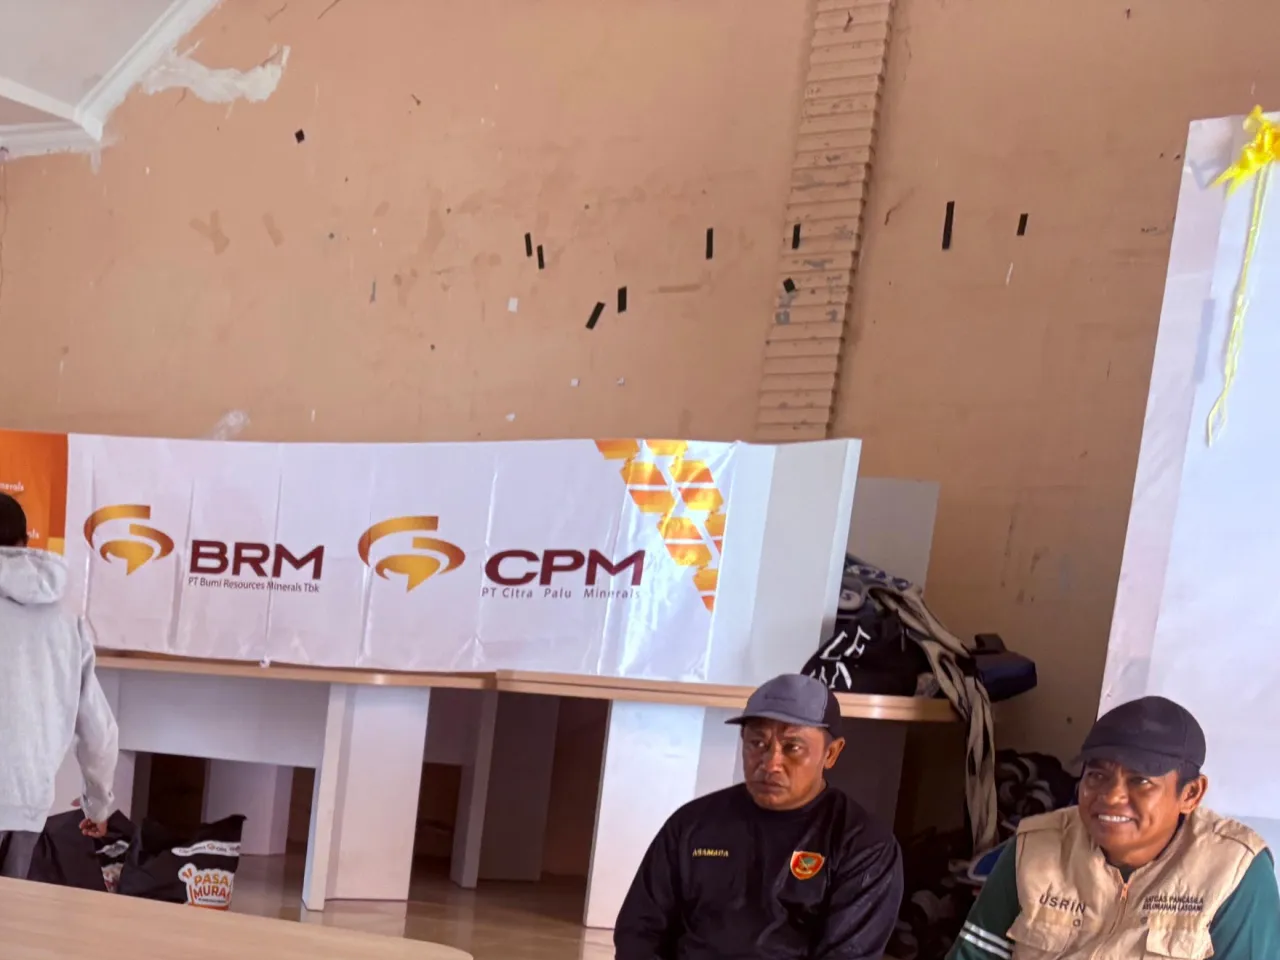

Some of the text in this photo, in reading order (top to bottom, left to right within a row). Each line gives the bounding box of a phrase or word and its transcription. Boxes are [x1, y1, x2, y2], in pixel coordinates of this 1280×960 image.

[190, 540, 324, 580] BRM
[485, 549, 646, 586] CPM
[188, 577, 319, 592] PT Bumi Resources Minerals Tbk
[482, 588, 640, 598] PT Citra Palu Minerals
[194, 873, 229, 886] PASA
[193, 884, 226, 899] MURA
[1039, 894, 1086, 914] USRIN
